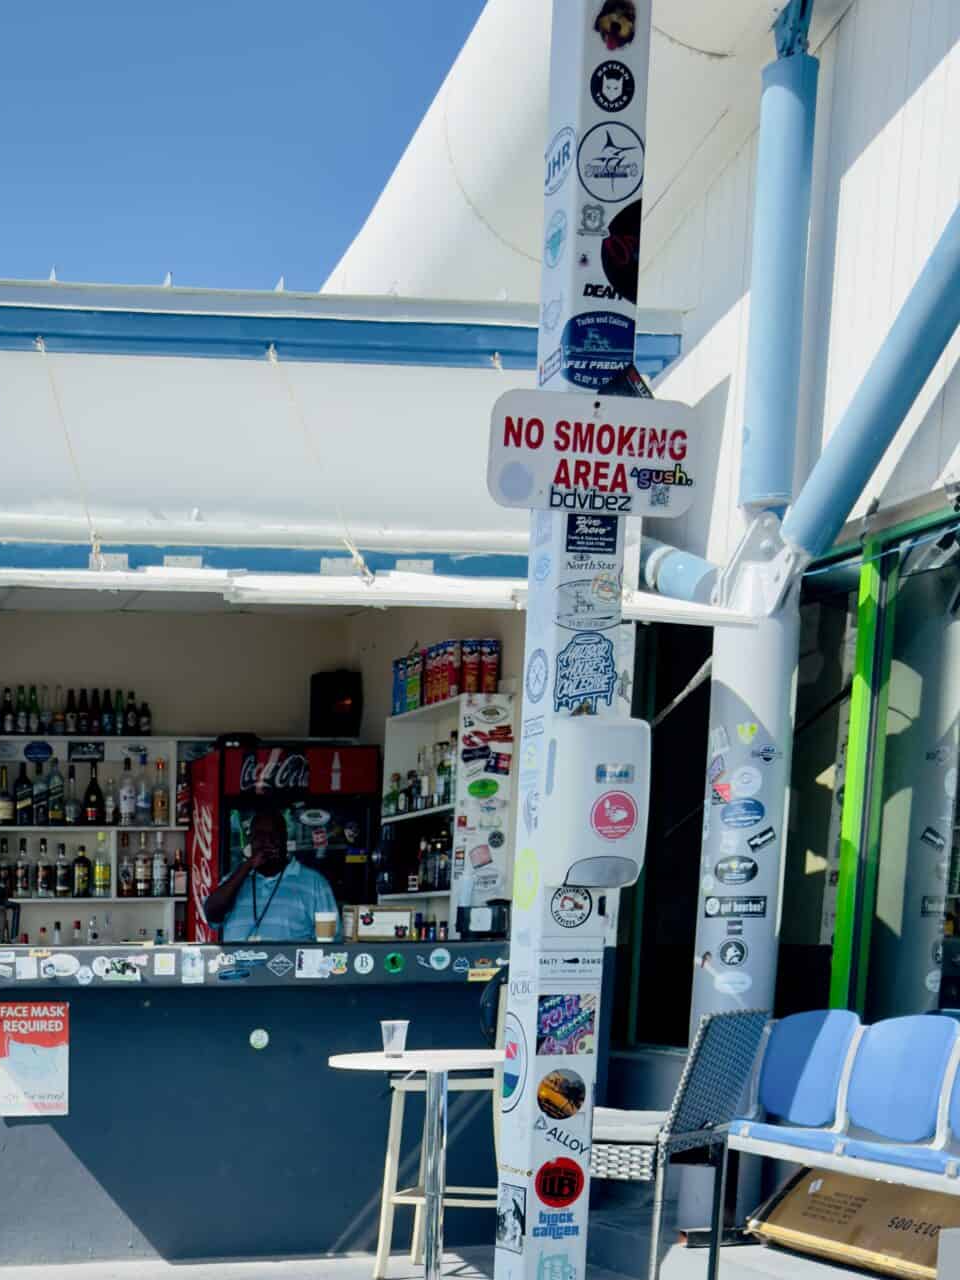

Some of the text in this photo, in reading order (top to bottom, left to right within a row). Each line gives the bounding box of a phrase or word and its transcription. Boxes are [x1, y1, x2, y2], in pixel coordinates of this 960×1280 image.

[503, 416, 689, 461] NO SMOKING
[552, 458, 629, 494] AREA
[0, 1006, 65, 1017] FACE MASK
[3, 1020, 64, 1034] REQUIRED
[546, 1127, 590, 1155] ALLOY
